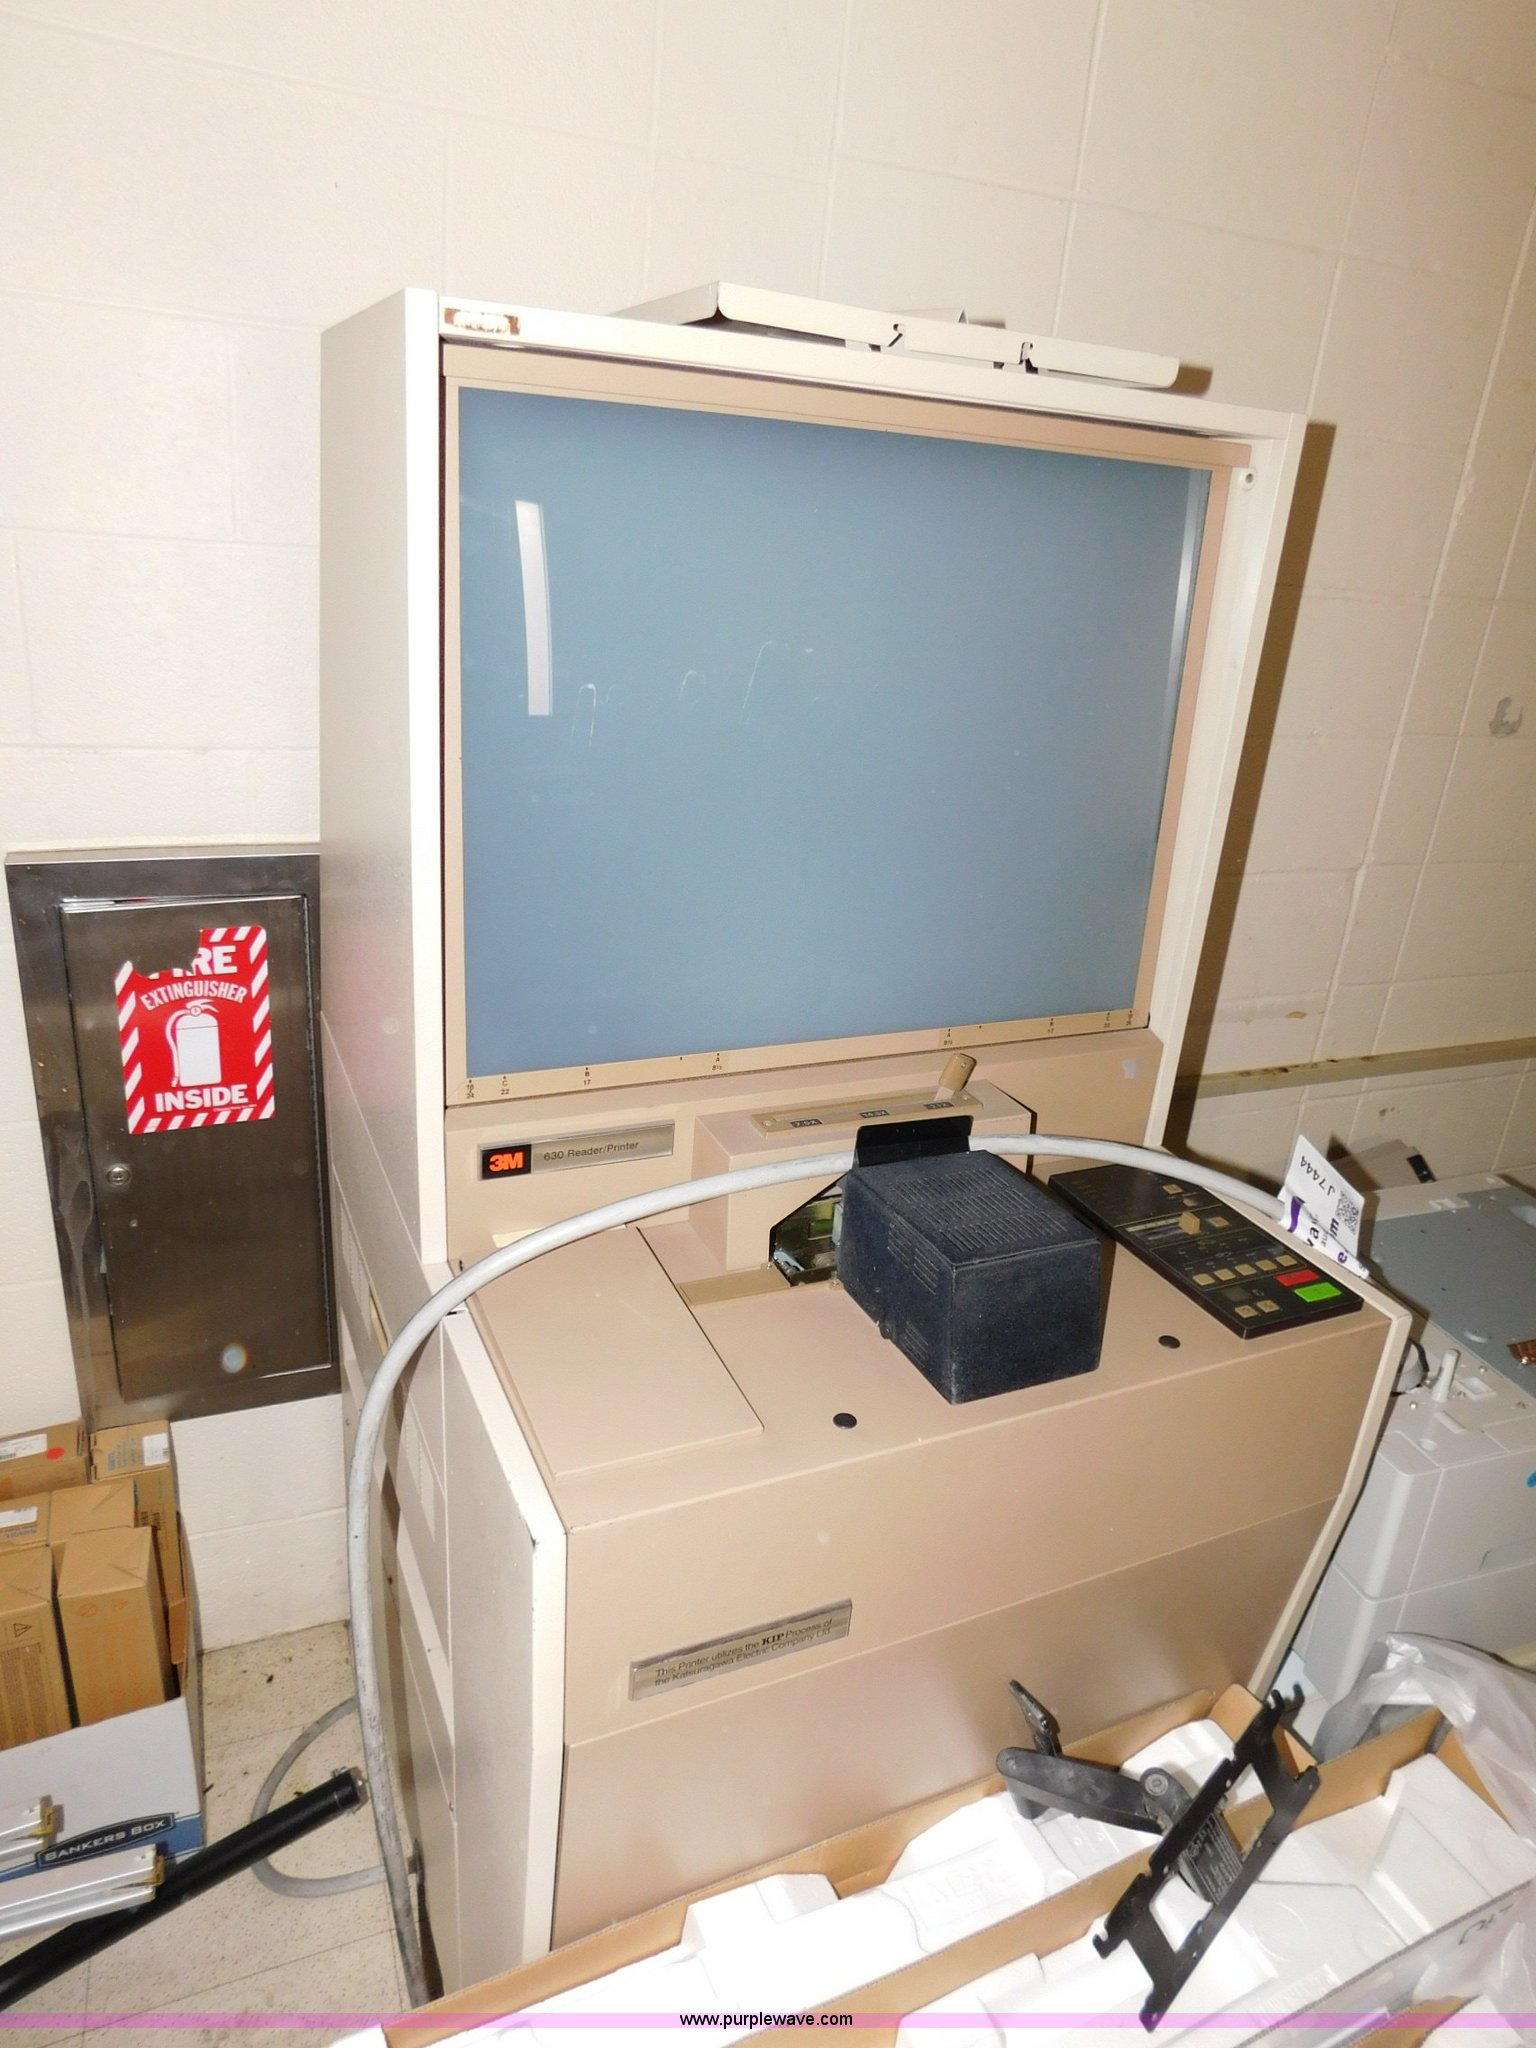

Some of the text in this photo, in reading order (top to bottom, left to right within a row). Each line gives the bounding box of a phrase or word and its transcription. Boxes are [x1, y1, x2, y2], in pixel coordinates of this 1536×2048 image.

[140, 980, 248, 1011] EXTINGUISHER
[155, 1084, 249, 1113] INSIDE
[489, 1141, 640, 1172] 3M 630 Reader/Printer
[1300, 1156, 1336, 1197] J7444
[655, 1677, 671, 1687] the
[736, 1646, 769, 1662] Electric
[771, 1634, 814, 1652] Company
[656, 1618, 833, 1677] This Printer utilizes the KIP Process of
[45, 1820, 166, 1861] BANKERS BOX
